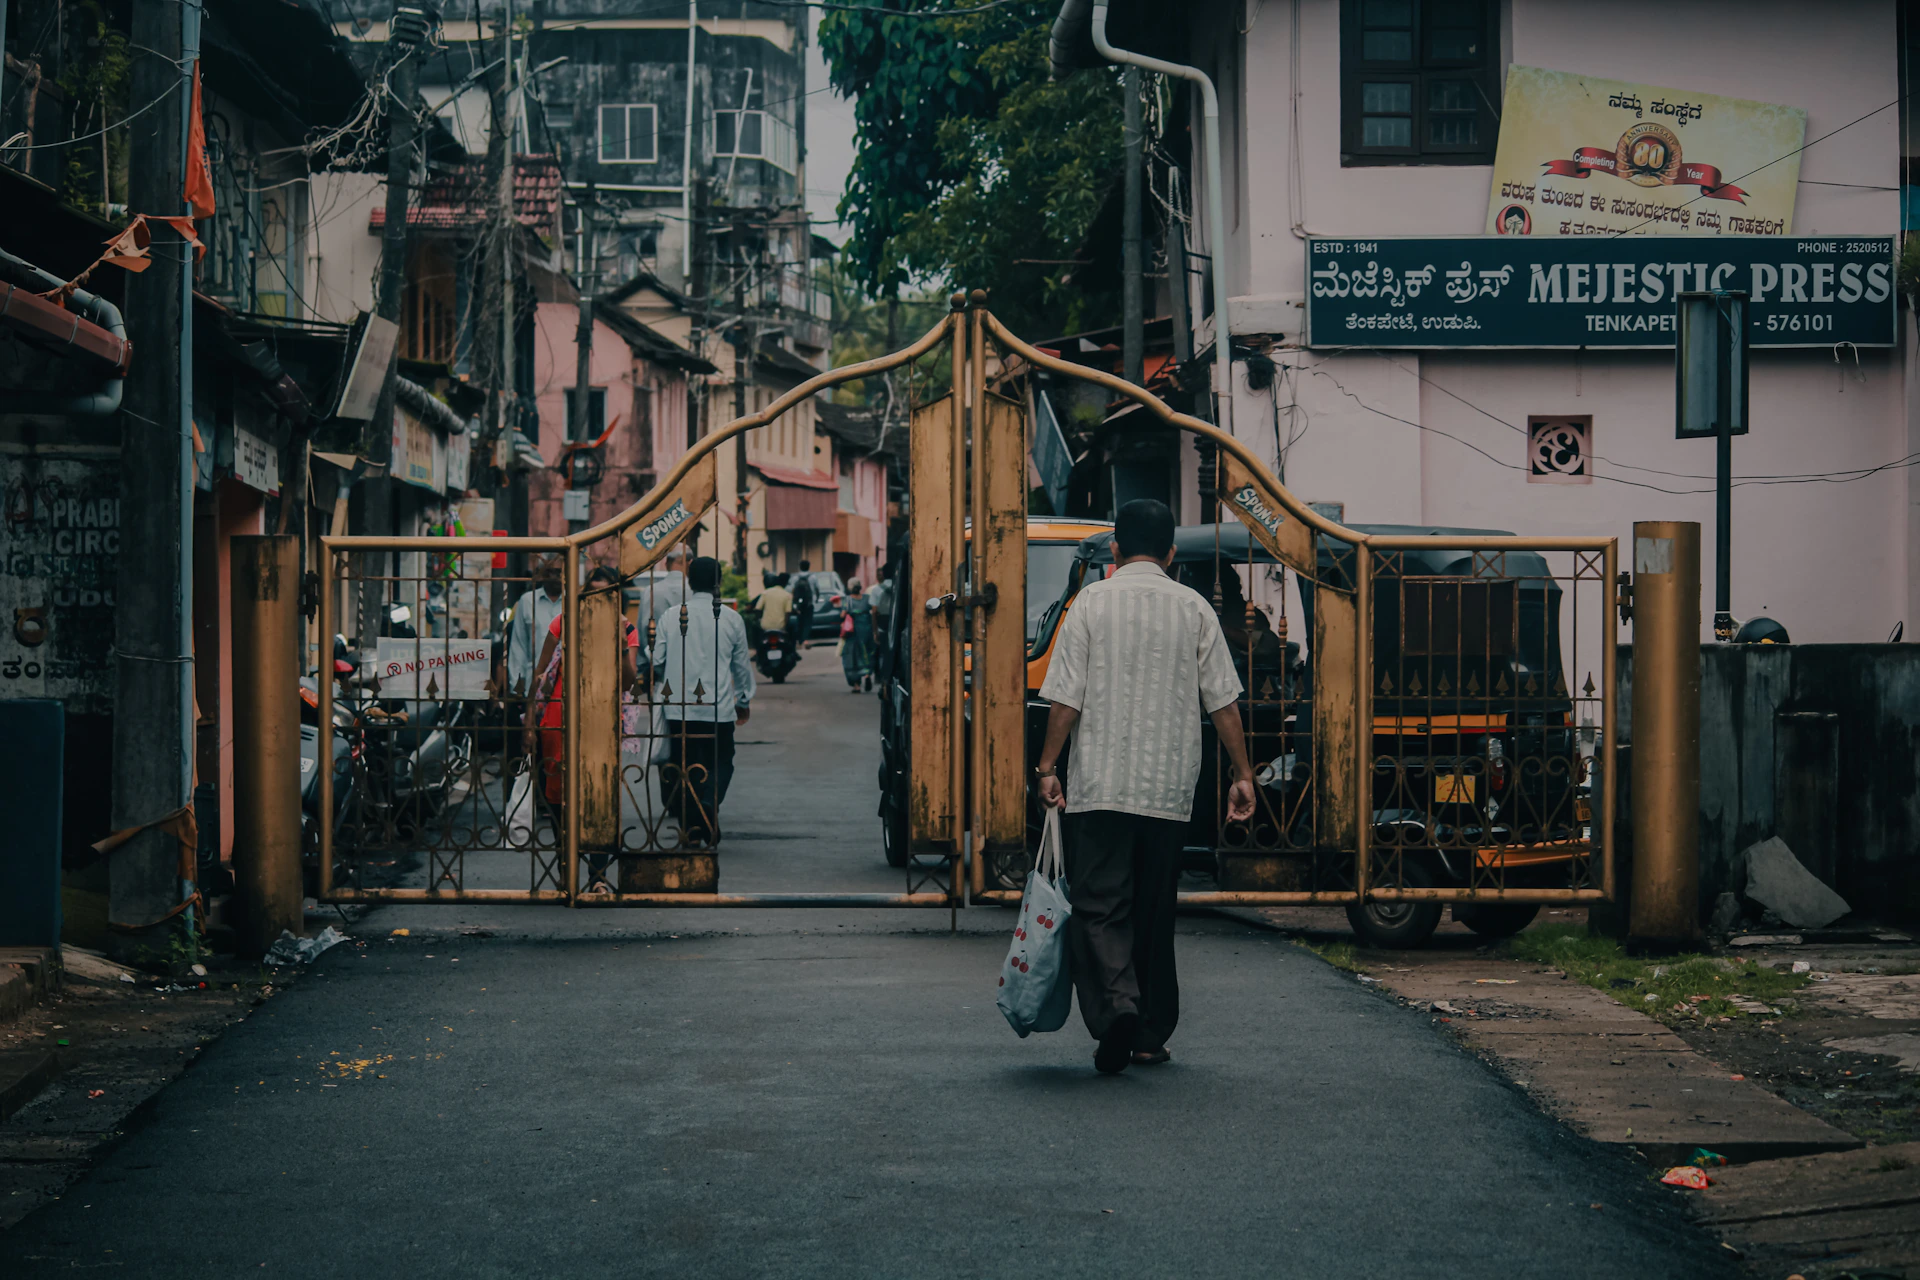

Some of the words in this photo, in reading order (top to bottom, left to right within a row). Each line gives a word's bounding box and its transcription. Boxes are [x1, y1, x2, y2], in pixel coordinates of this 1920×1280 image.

[1608, 92, 1643, 118] ನಮ್ಮ
[1650, 98, 1702, 127] ಸಂಸ್ಥೆಗೆ
[1626, 125, 1676, 145] ANNIVERSARY
[1573, 152, 1615, 169] Completing
[1633, 142, 1664, 168] 80
[1686, 168, 1704, 180] Year
[1501, 179, 1536, 204] ವರುಷ
[1541, 186, 1585, 209] ತುಂಬಿದ
[1590, 193, 1606, 212] ಈ
[1696, 207, 1721, 235] ನಮ್ಮ
[1313, 242, 1344, 254] ESTD
[1354, 242, 1378, 254] 1941
[1797, 242, 1837, 254] PHONE
[1846, 242, 1889, 254] 2520512
[1312, 261, 1436, 307] ಮೆಜೆಸ್ಟಿಕ್
[1445, 261, 1515, 303] ಪ್ರೆಸ್
[1750, 262, 1890, 303] PRESS
[1422, 314, 1482, 330] ಉಡುಪಿ.
[1766, 314, 1833, 331] 576101
[642, 503, 689, 548] SPONEX
[405, 660, 424, 673] NO
[428, 649, 485, 669] PARKING
